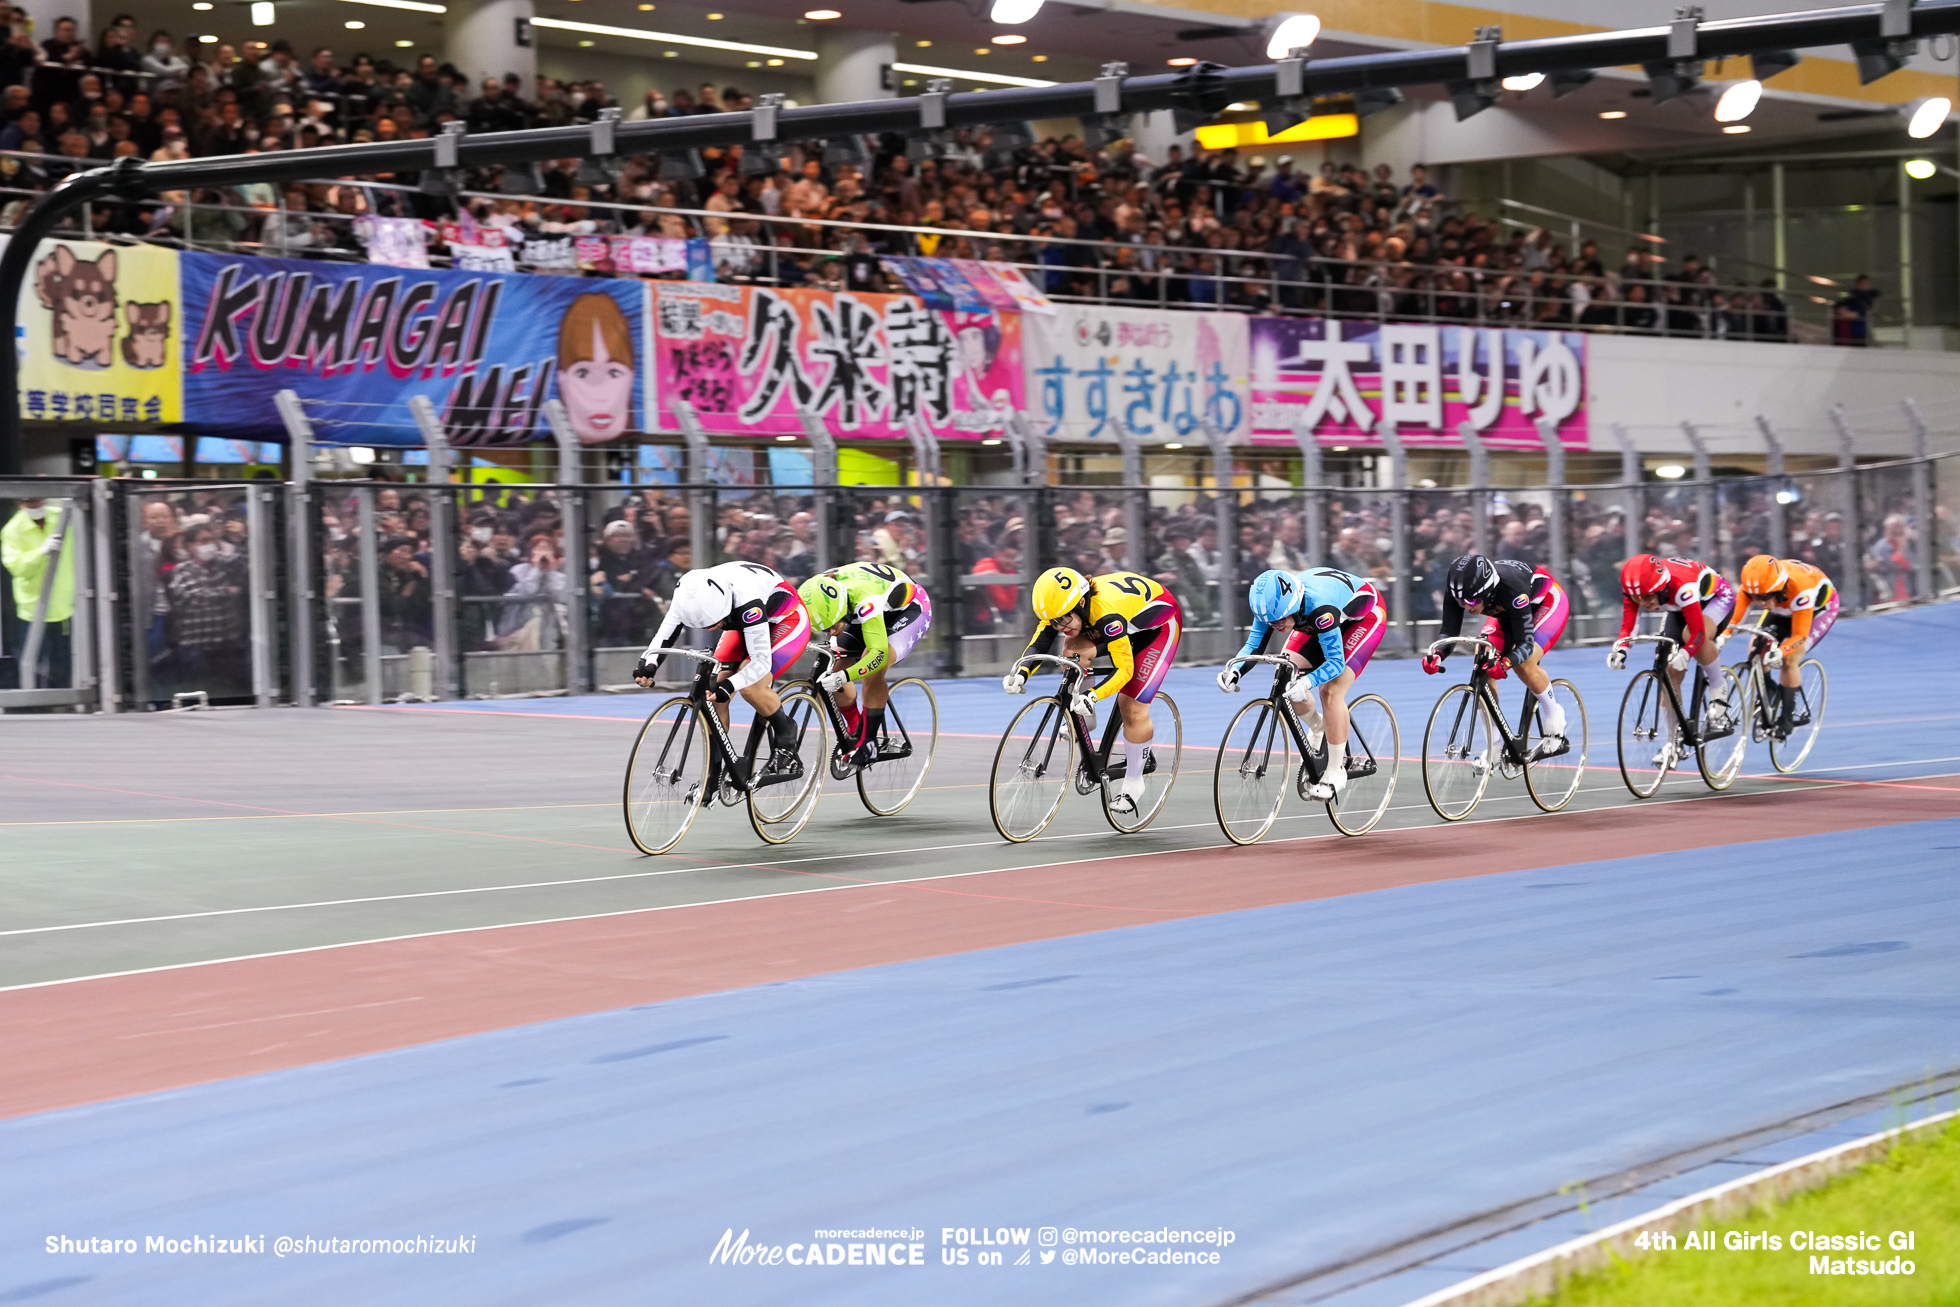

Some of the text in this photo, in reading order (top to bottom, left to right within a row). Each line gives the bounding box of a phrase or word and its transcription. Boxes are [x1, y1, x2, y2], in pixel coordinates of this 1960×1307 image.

[192, 263, 505, 379] KUMAGAI
[739, 287, 959, 428] 久米詩
[1300, 320, 1582, 432] 太田りゆ
[445, 357, 557, 446] MEI
[1477, 560, 1492, 579] 2
[1651, 556, 1664, 575] 3
[706, 578, 725, 596] 1
[819, 582, 838, 600] 6
[1053, 571, 1073, 591] 5
[1107, 576, 1152, 603] 5
[1277, 575, 1294, 597] 4
[1313, 569, 1356, 594] 4
[771, 623, 792, 645] EIRIN
[1344, 626, 1368, 652] KEIRIN
[866, 649, 886, 672] KEIRIN
[1136, 648, 1162, 683] KEIRIN
[1484, 683, 1515, 741] BRIDGESTONE
[705, 699, 739, 765] BRIDGESTONE
